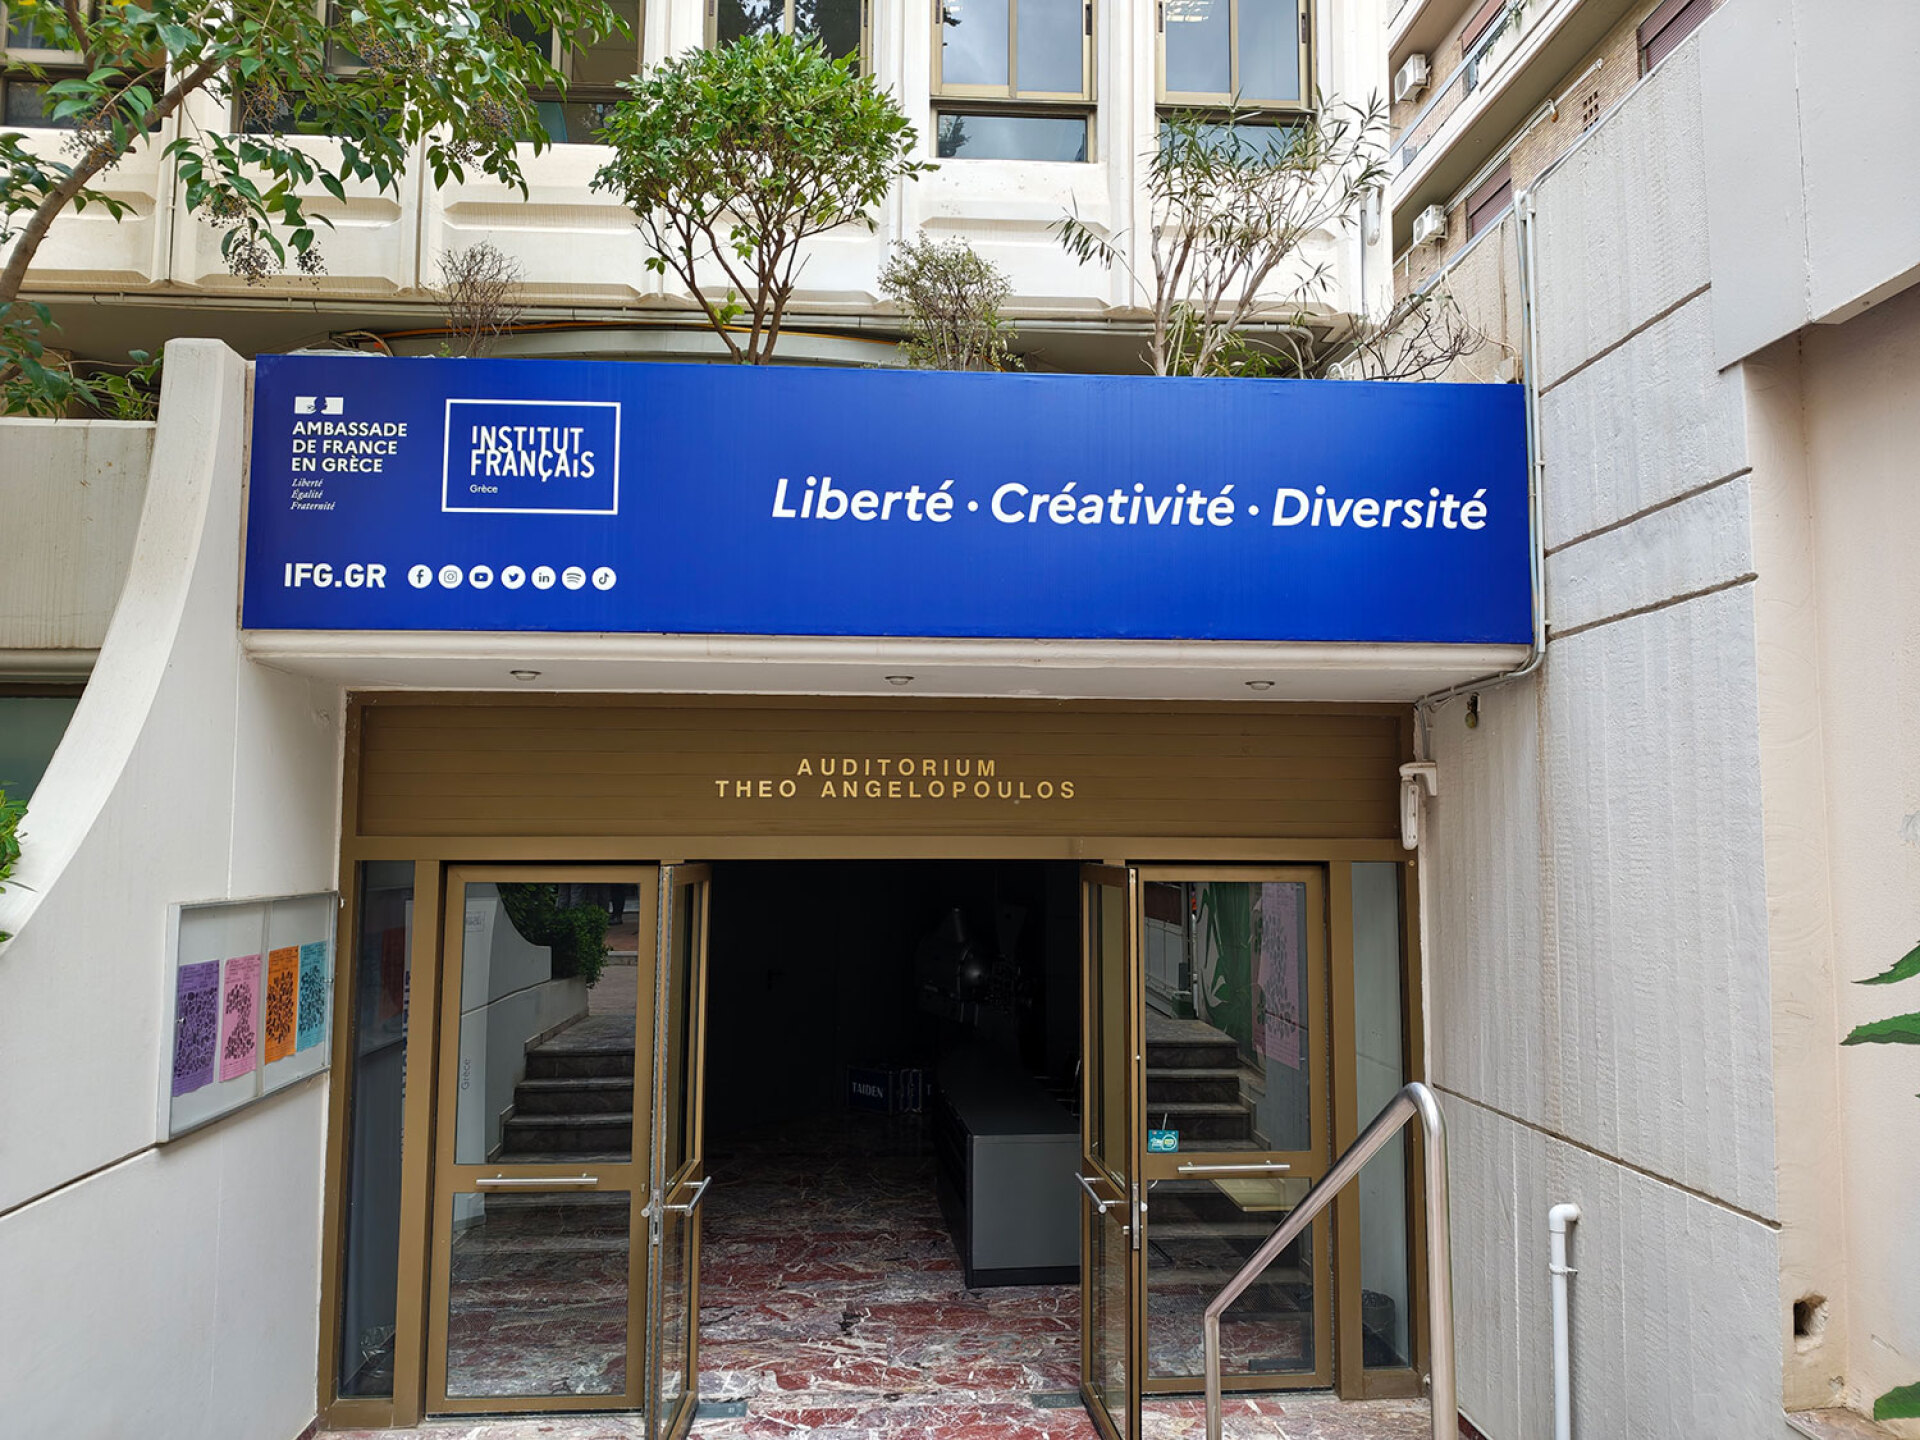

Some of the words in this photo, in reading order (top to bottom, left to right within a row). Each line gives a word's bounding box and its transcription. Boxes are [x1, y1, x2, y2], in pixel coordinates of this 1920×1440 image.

[292, 421, 408, 437] AMBASSADE
[292, 439, 317, 454] DE
[322, 440, 398, 455] FRANCE
[472, 425, 584, 454] INSTITUT
[291, 457, 316, 472] EN
[322, 455, 383, 473] GRÈCE
[470, 450, 595, 482] FRANÇAIS
[291, 478, 323, 487] Liberté
[469, 484, 499, 494] Grèce
[291, 488, 323, 500] Égalité
[772, 475, 954, 523] Liberté
[991, 481, 1235, 527] Créativité
[1272, 484, 1487, 530] Diversité
[290, 501, 336, 511] Fraternité
[284, 562, 387, 588] IFG.GR
[797, 758, 997, 777] AUDITORIUM
[715, 780, 797, 799] THEO
[820, 780, 1076, 799] ANGELOPOULOS
